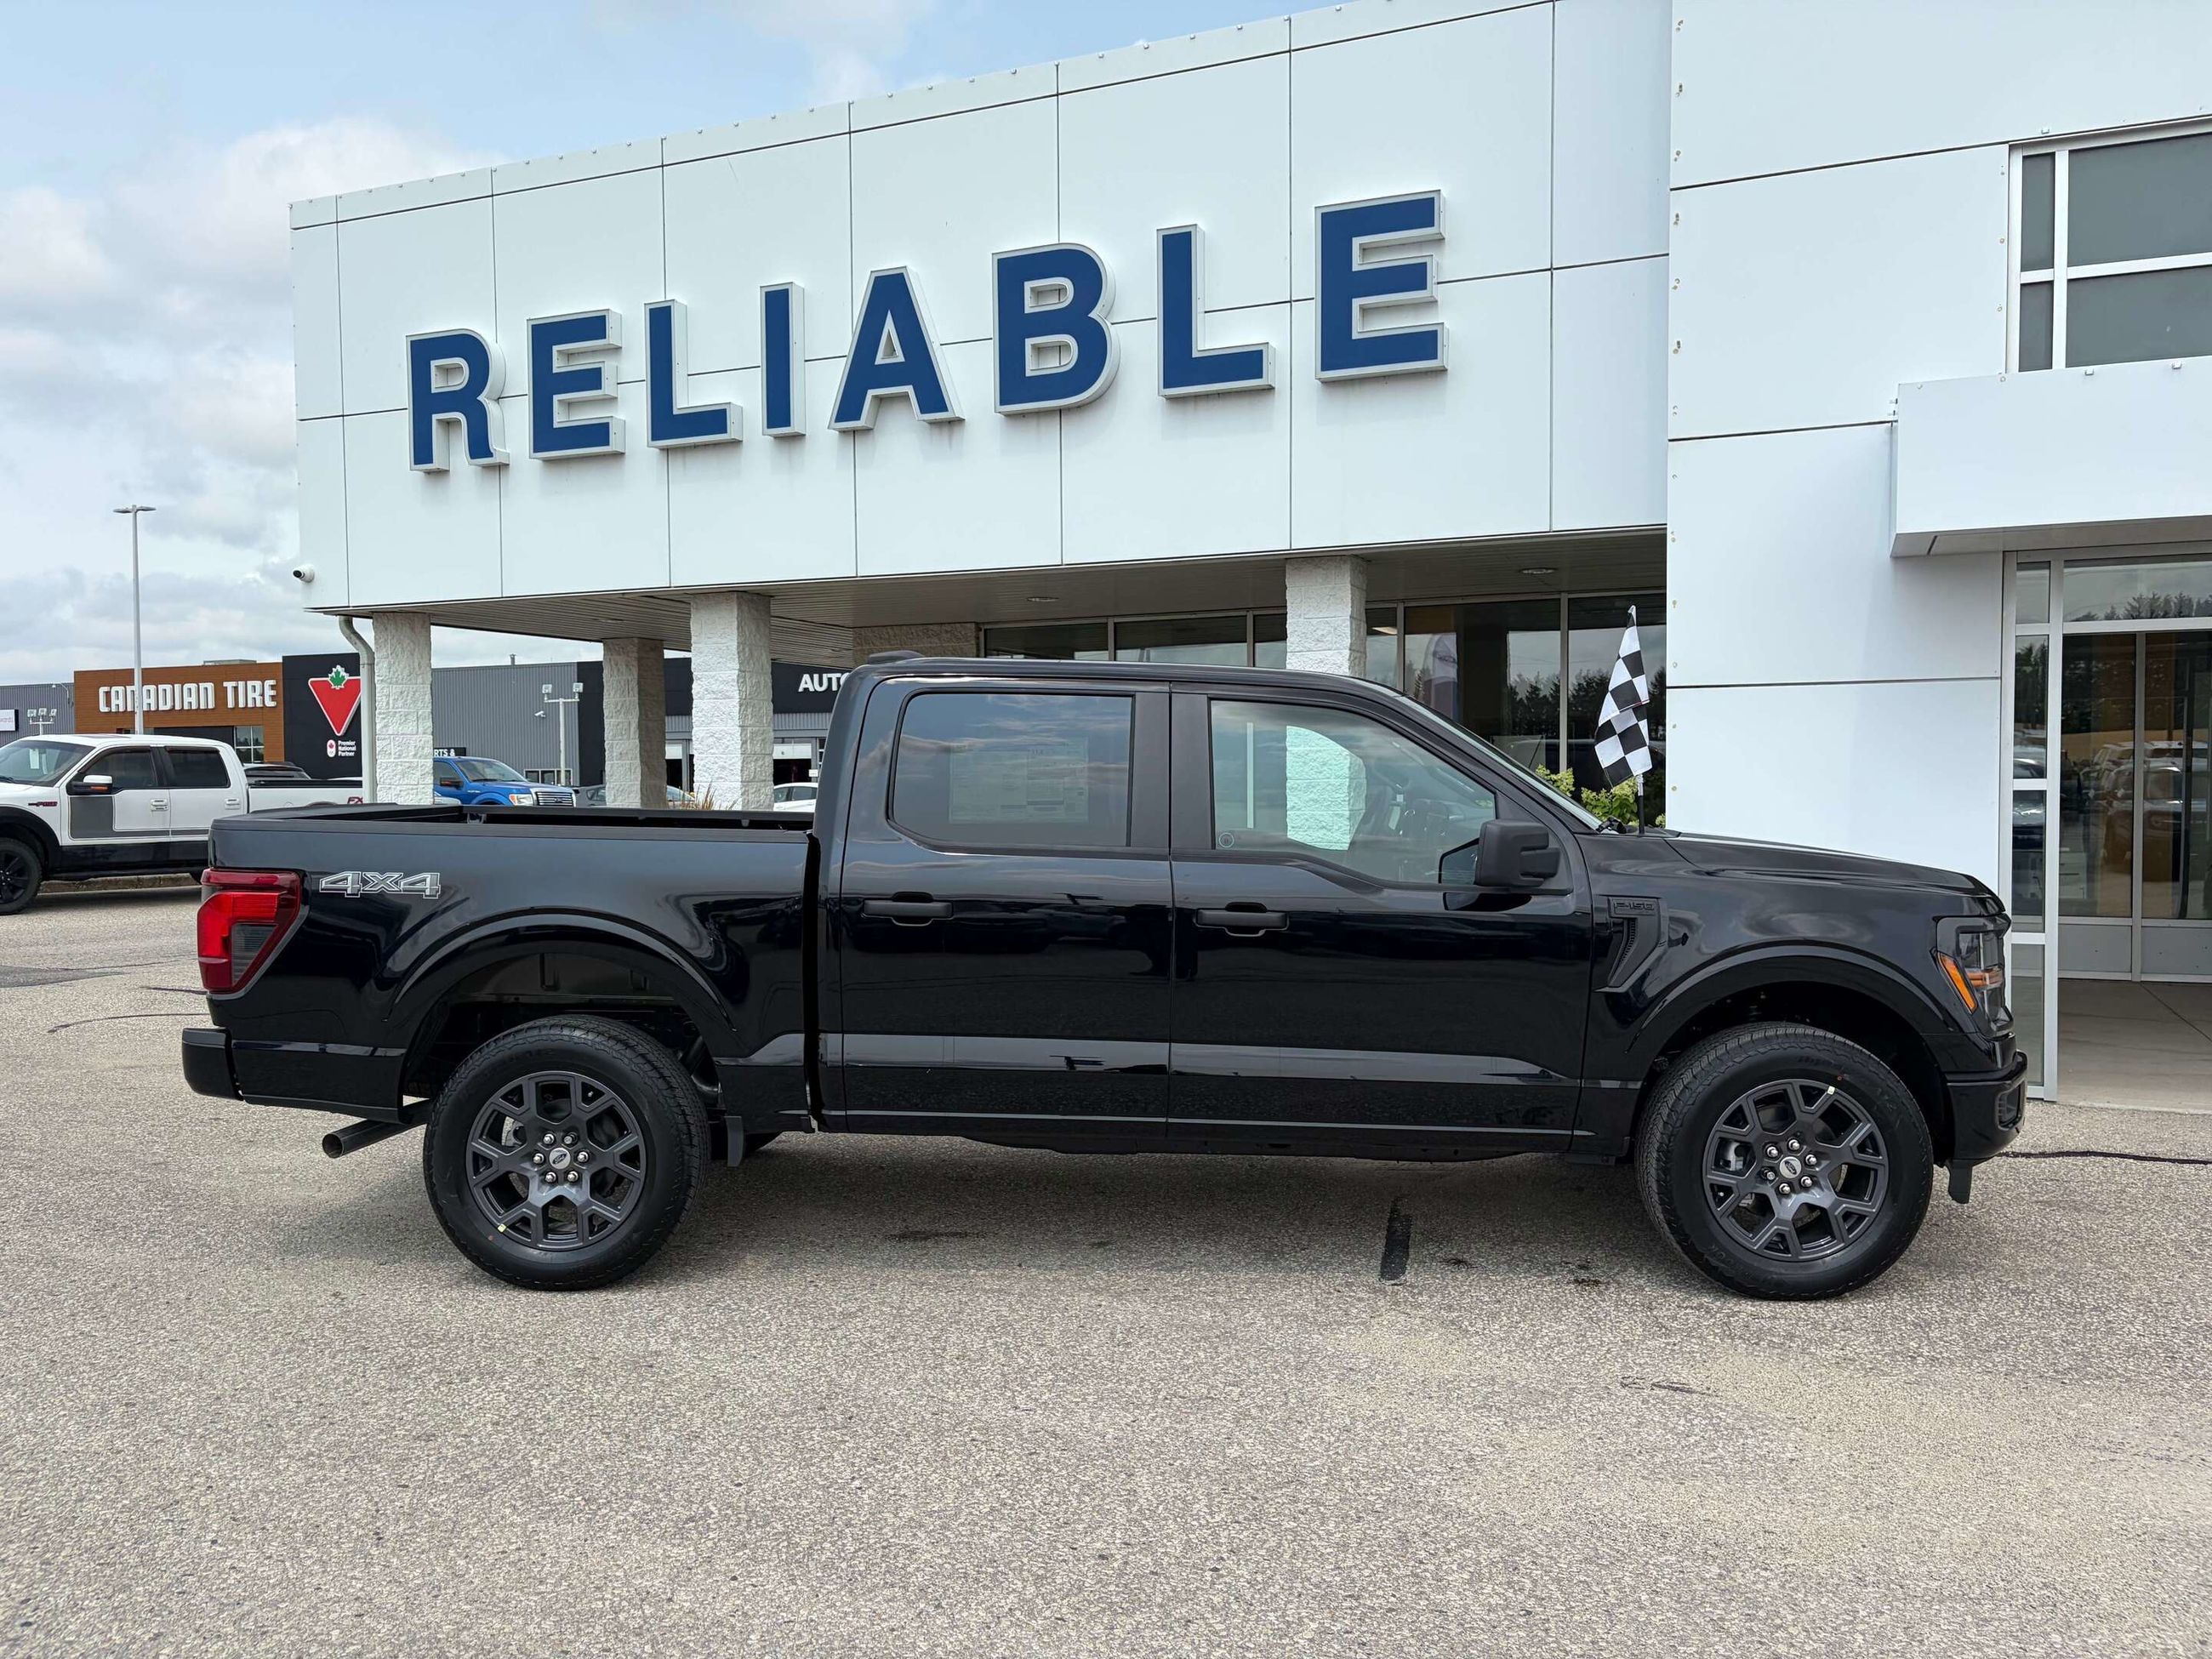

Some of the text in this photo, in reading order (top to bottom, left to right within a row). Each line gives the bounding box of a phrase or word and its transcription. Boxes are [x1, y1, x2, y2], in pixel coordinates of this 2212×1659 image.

[405, 189, 1450, 474] RELIABLE
[99, 679, 277, 713] CANADIAN TIRE
